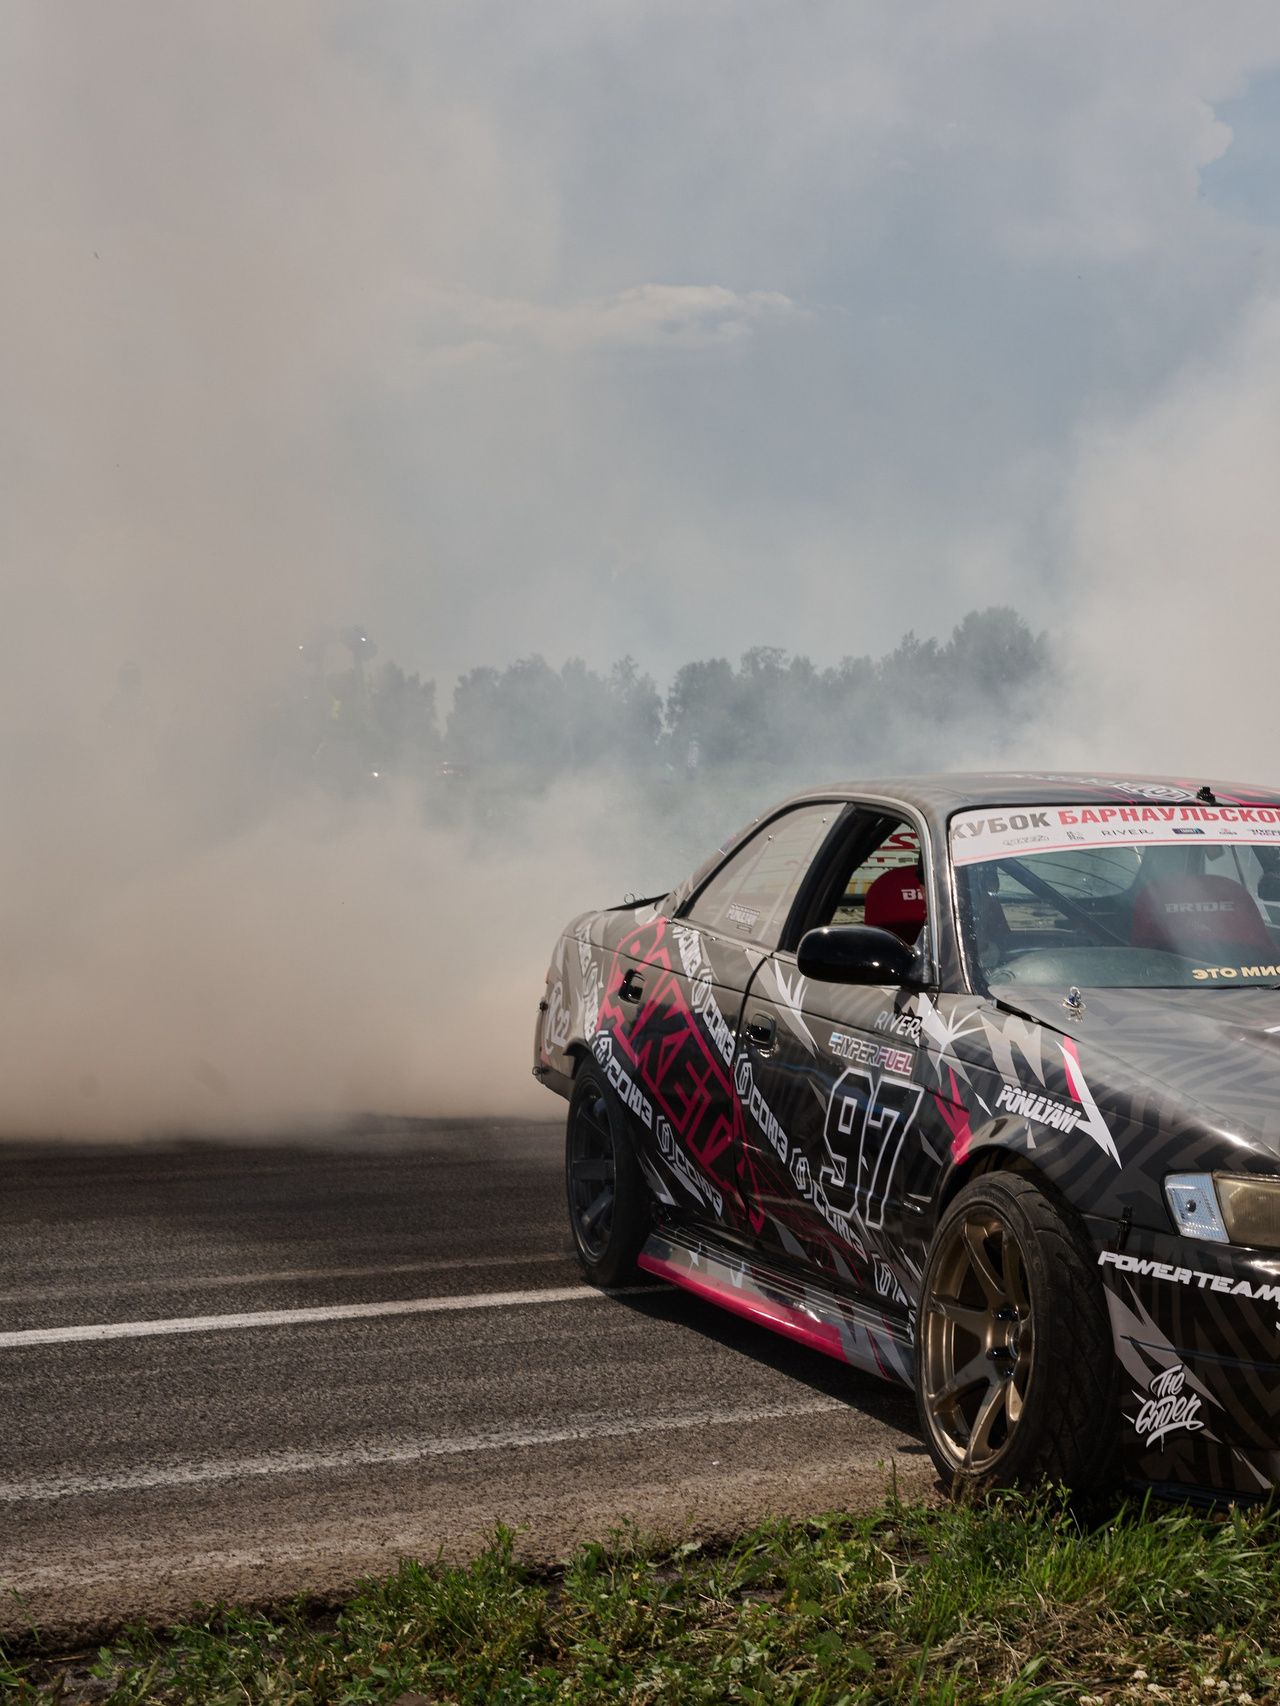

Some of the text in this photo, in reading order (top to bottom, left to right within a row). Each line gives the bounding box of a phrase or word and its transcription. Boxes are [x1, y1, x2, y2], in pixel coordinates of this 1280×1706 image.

[951, 812, 1051, 840] КУБОК
[1164, 901, 1235, 913] BRIDE
[1192, 967, 1238, 980] ЭТО
[819, 1067, 925, 1230] 97
